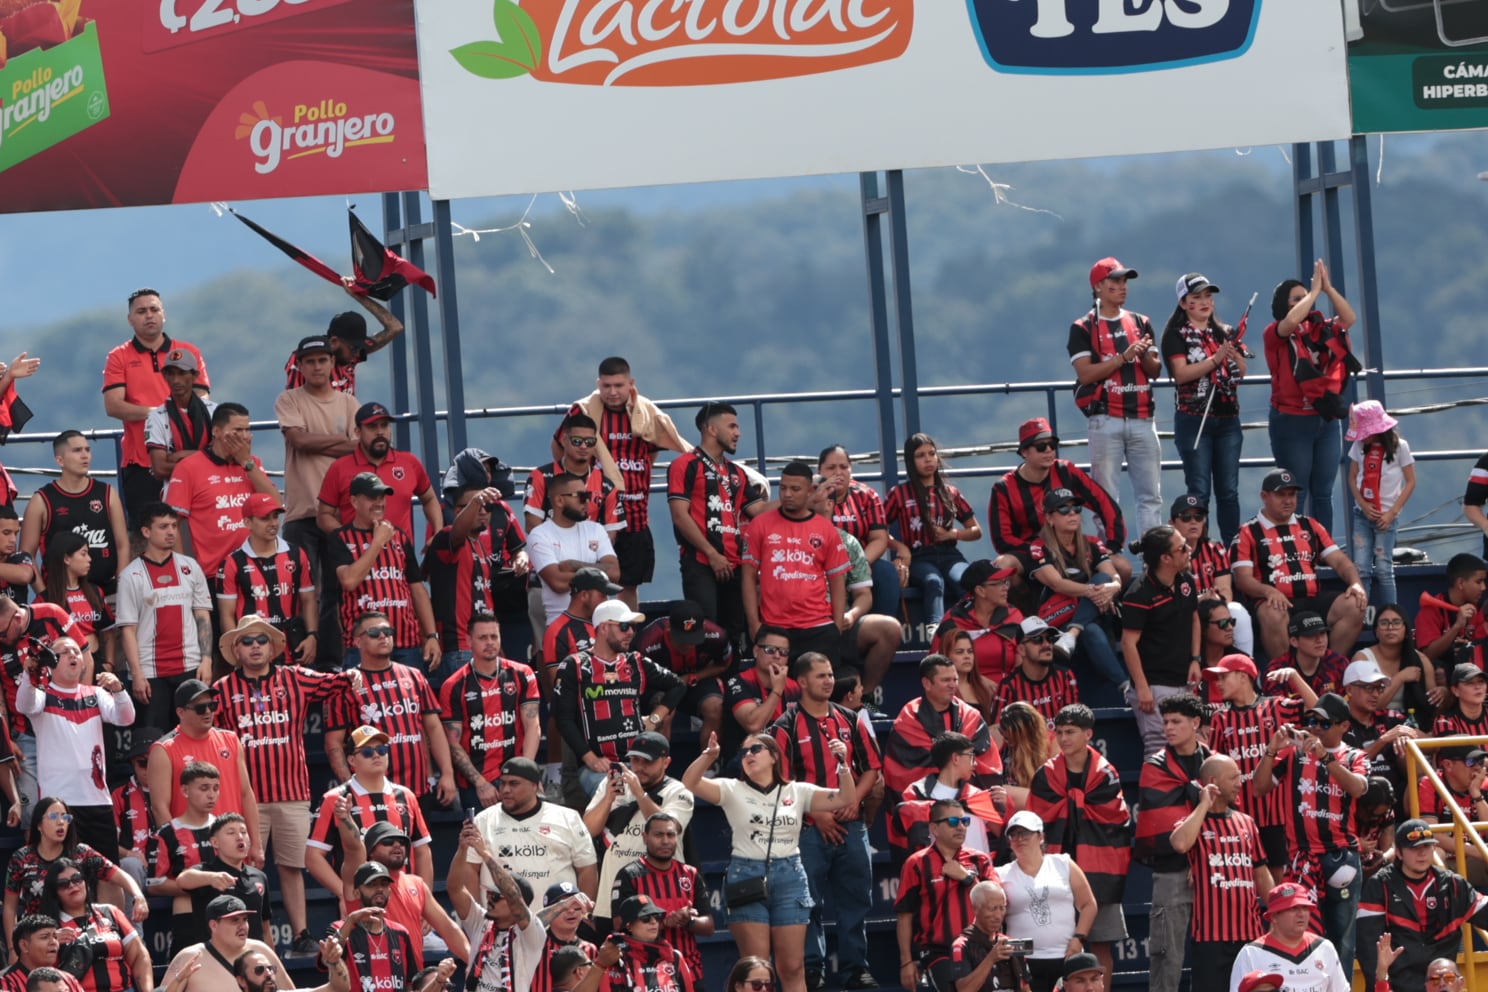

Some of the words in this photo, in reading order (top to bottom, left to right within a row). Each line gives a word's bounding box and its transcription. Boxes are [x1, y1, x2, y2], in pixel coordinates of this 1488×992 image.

[13, 66, 53, 99] Pollo
[294, 100, 347, 123] Pollo
[250, 111, 395, 174] granjero
[381, 701, 418, 717] kölbi
[253, 711, 288, 724] kölbi
[484, 712, 515, 727] kölbi
[247, 736, 289, 746] medismart
[375, 977, 404, 991] kölbi
